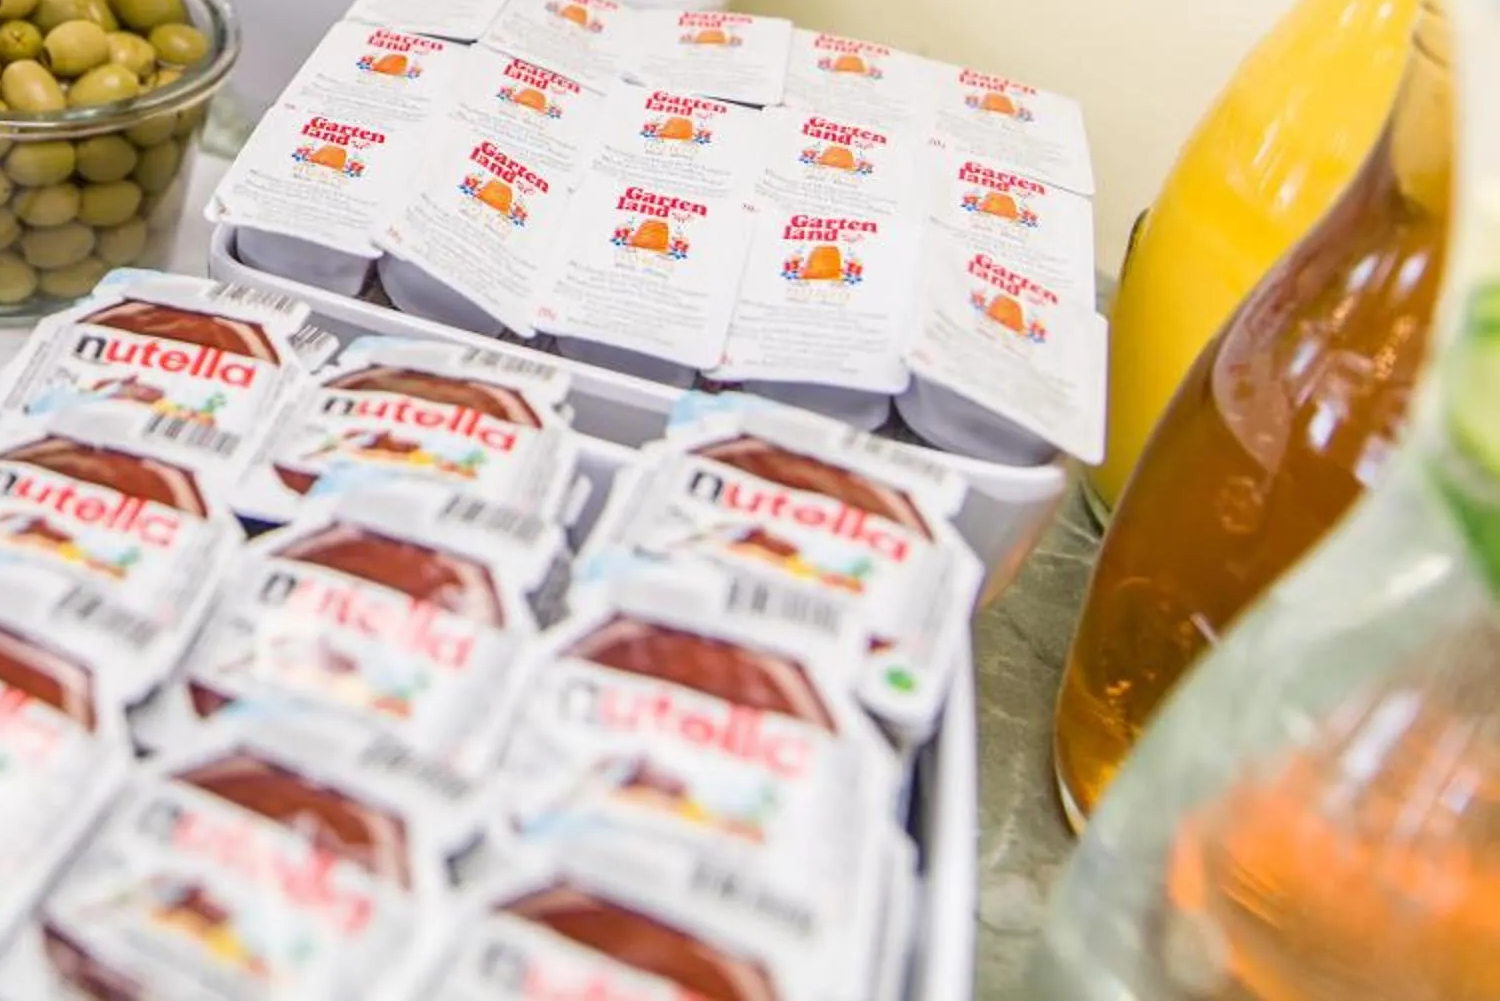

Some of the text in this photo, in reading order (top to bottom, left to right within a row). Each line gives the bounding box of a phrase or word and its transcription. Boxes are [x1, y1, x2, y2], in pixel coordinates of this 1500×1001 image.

[504, 64, 550, 89] land
[512, 57, 581, 95] Garten
[644, 99, 693, 116] land
[650, 89, 728, 115] Garten
[301, 124, 350, 146] land
[309, 116, 387, 145] Garten
[801, 123, 853, 146] land
[807, 116, 888, 145] Garten
[468, 146, 519, 184] land
[479, 139, 550, 194] Garten
[957, 167, 1011, 192] land
[963, 160, 1047, 196] Garten
[615, 196, 669, 219] land
[624, 186, 709, 218] Garten
[782, 224, 839, 243] land
[790, 214, 879, 235] Garten
[967, 260, 1022, 297] land
[974, 253, 1059, 305] Garten
[73, 334, 258, 389] nutella
[321, 396, 519, 454] nutella
[686, 470, 912, 563] nutella
